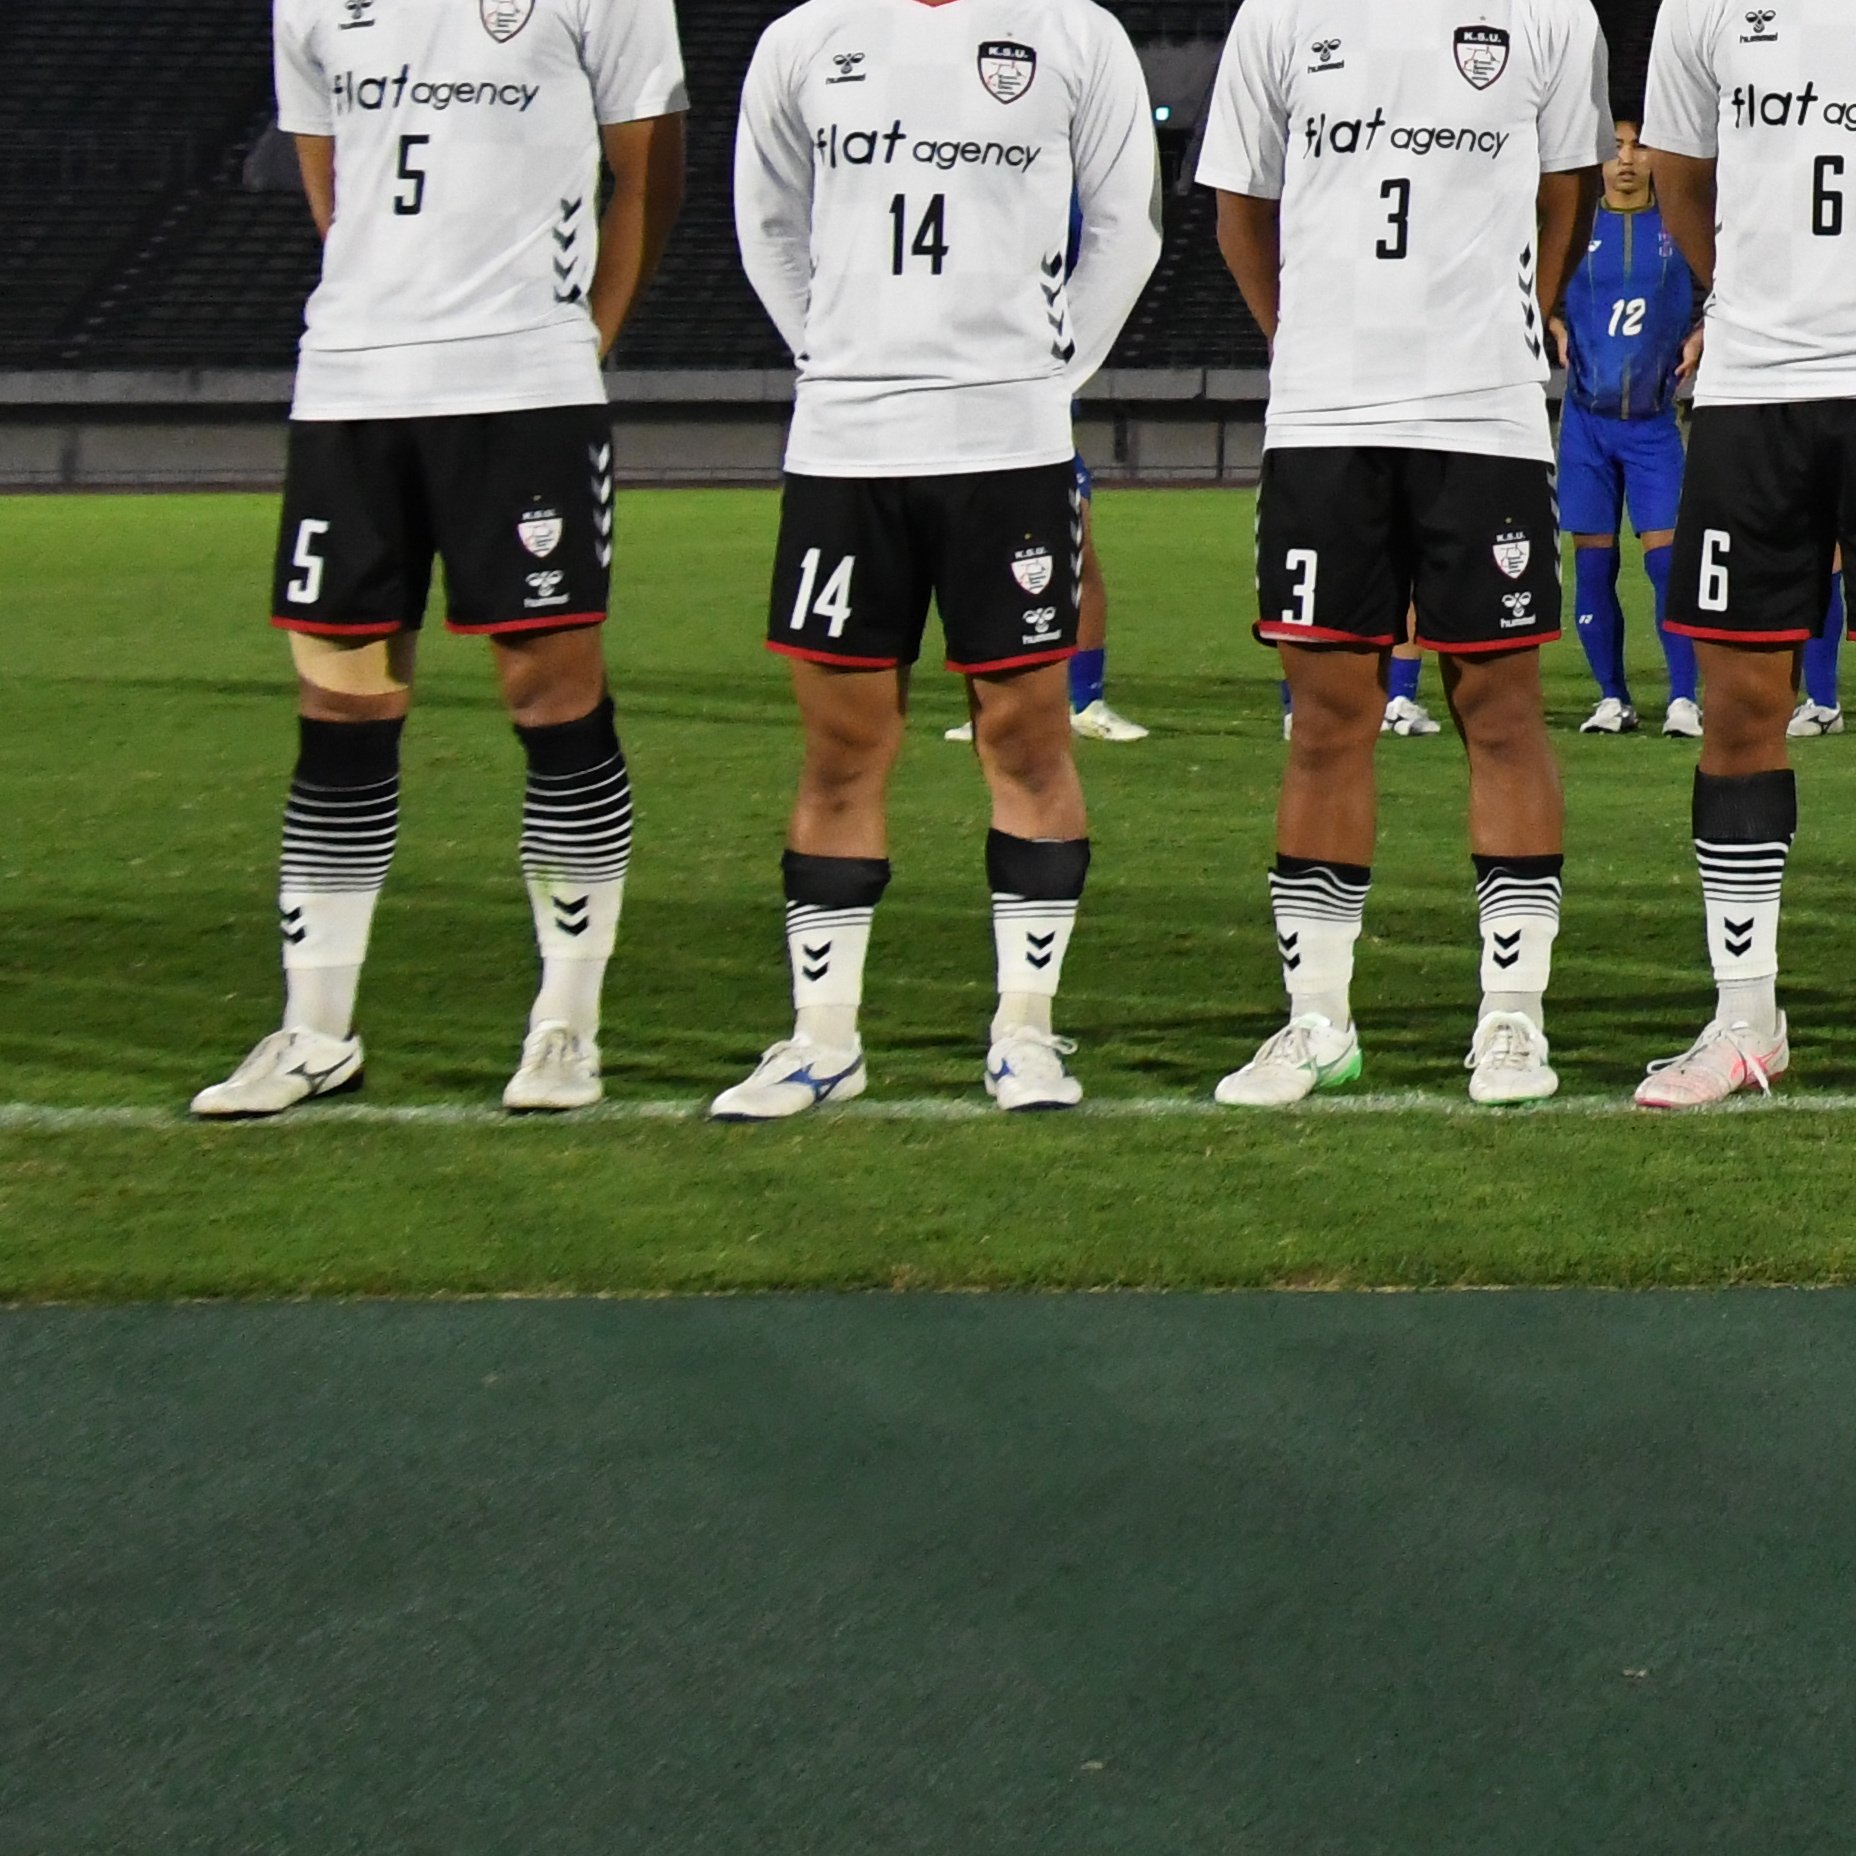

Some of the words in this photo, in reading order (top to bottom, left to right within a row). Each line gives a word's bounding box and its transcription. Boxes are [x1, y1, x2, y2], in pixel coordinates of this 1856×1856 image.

[1463, 31, 1502, 43] K.S.U.
[411, 81, 540, 112] agency
[1303, 107, 1386, 160] flat
[1390, 127, 1509, 160] agency
[1731, 81, 1818, 128] flat
[394, 134, 430, 215] 5
[816, 119, 906, 168] flat
[912, 141, 1041, 173] agency
[889, 193, 949, 275] 14
[1376, 177, 1410, 259] 3
[1812, 155, 1844, 236] 6
[1608, 297, 1647, 337] 12
[287, 518, 331, 604] 5
[789, 547, 855, 638] 14
[1281, 548, 1318, 626] 3
[1698, 528, 1731, 612] 6
